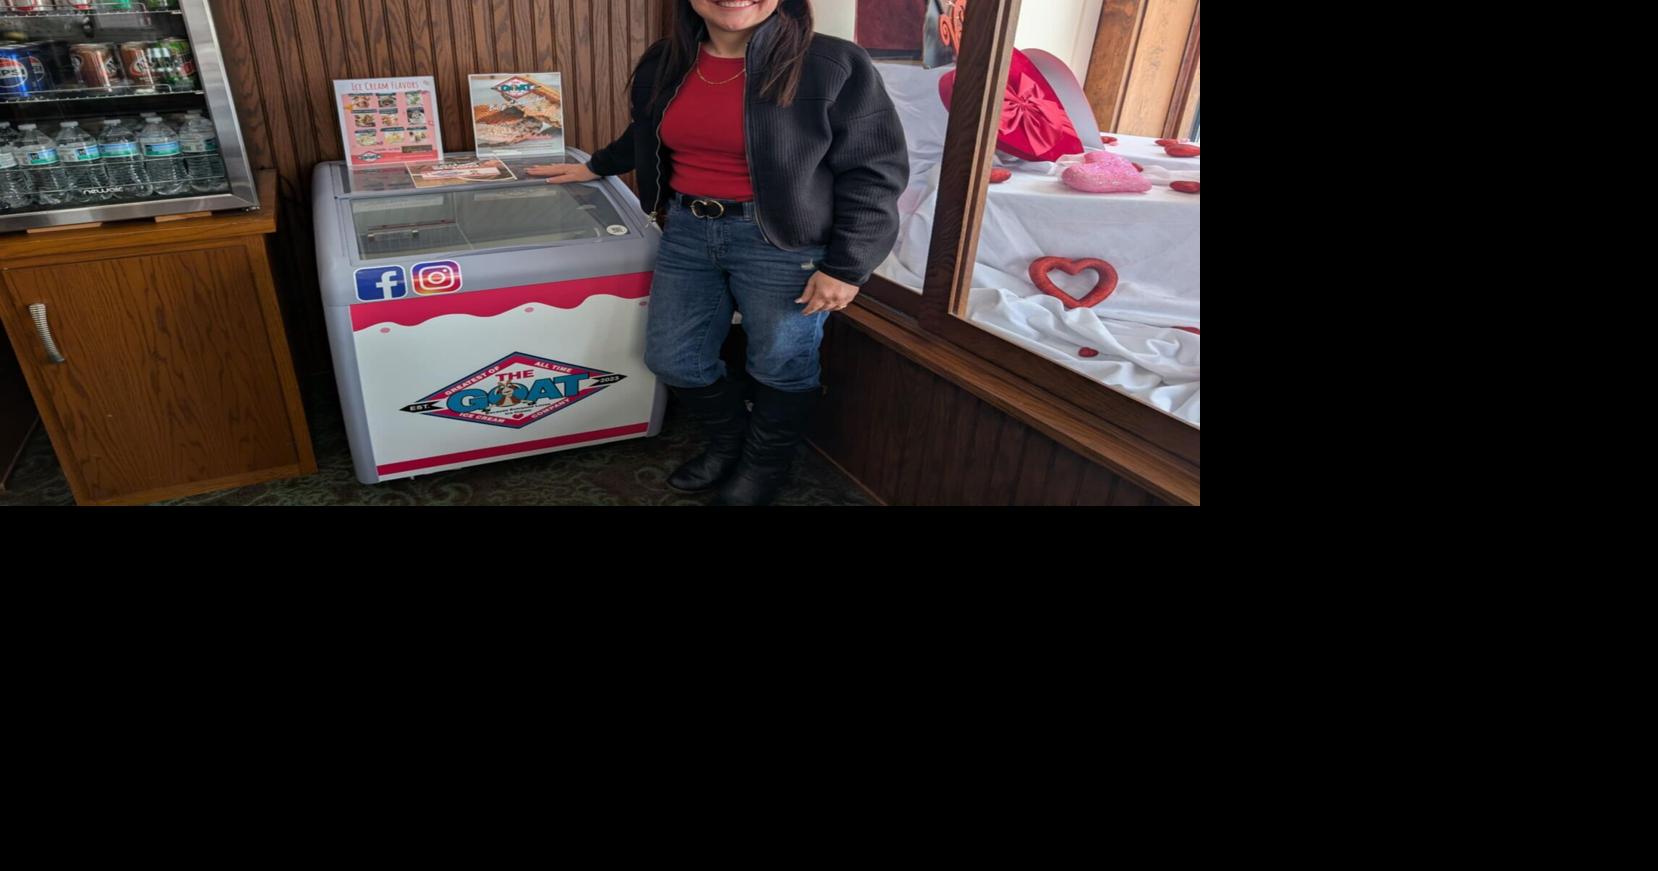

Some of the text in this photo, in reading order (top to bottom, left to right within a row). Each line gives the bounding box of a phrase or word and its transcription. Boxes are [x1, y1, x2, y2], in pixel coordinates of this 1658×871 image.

[0, 68, 25, 76] PSI
[351, 81, 419, 91] ICE CREAM FLAVORS
[533, 361, 573, 373] ALL TIME
[444, 365, 500, 396] GREATEST OF
[495, 369, 535, 382] THE
[600, 375, 620, 383] 2023
[446, 373, 590, 413] GOAT
[531, 398, 571, 419] COMPANY
[475, 414, 506, 423] CREAM
